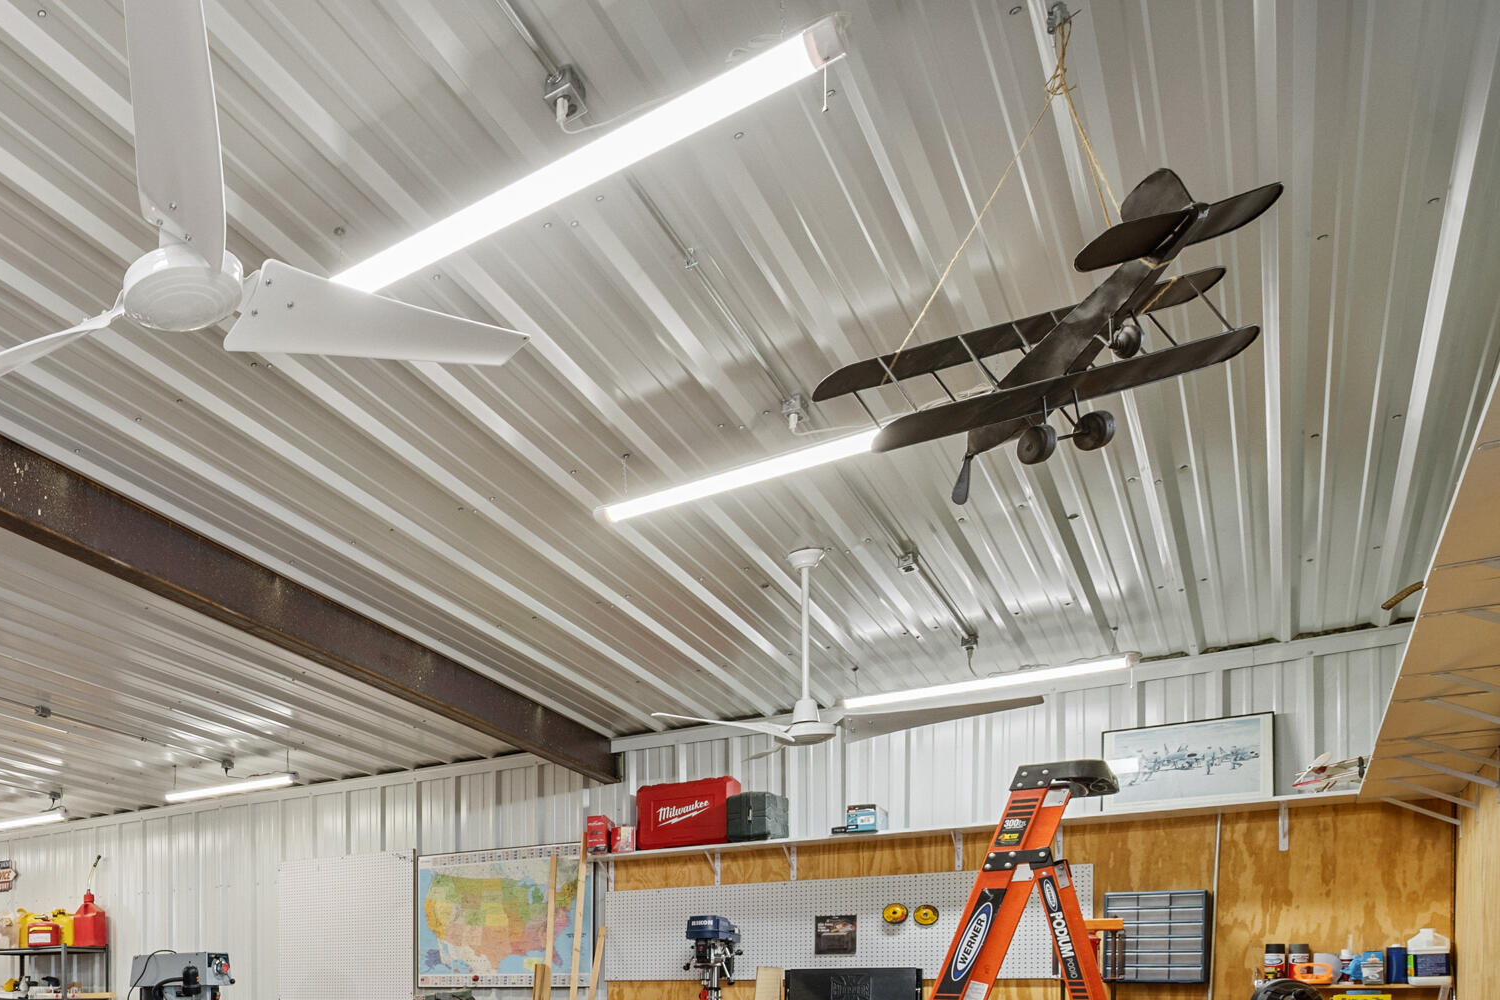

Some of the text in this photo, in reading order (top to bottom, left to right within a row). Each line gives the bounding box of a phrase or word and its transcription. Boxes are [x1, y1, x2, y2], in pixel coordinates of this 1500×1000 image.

[656, 800, 709, 821] Milwaukee
[959, 917, 985, 966] WERNER
[1050, 911, 1075, 957] PODIUM
